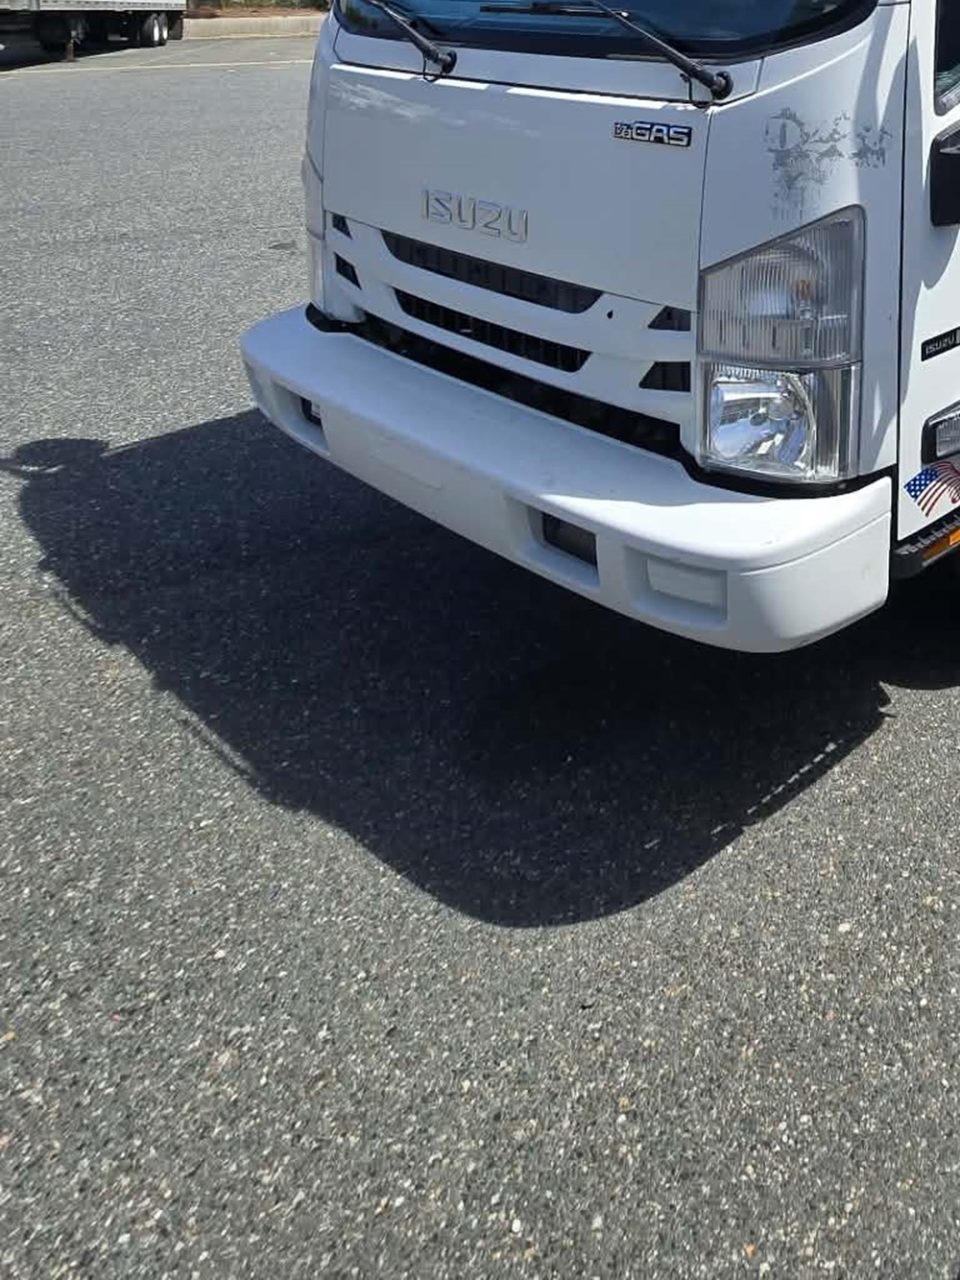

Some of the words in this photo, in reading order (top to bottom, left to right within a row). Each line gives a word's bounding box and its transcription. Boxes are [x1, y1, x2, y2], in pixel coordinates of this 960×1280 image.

[633, 122, 691, 146] GAS
[422, 188, 529, 243] ISUZU
[925, 332, 955, 356] ISUZU
